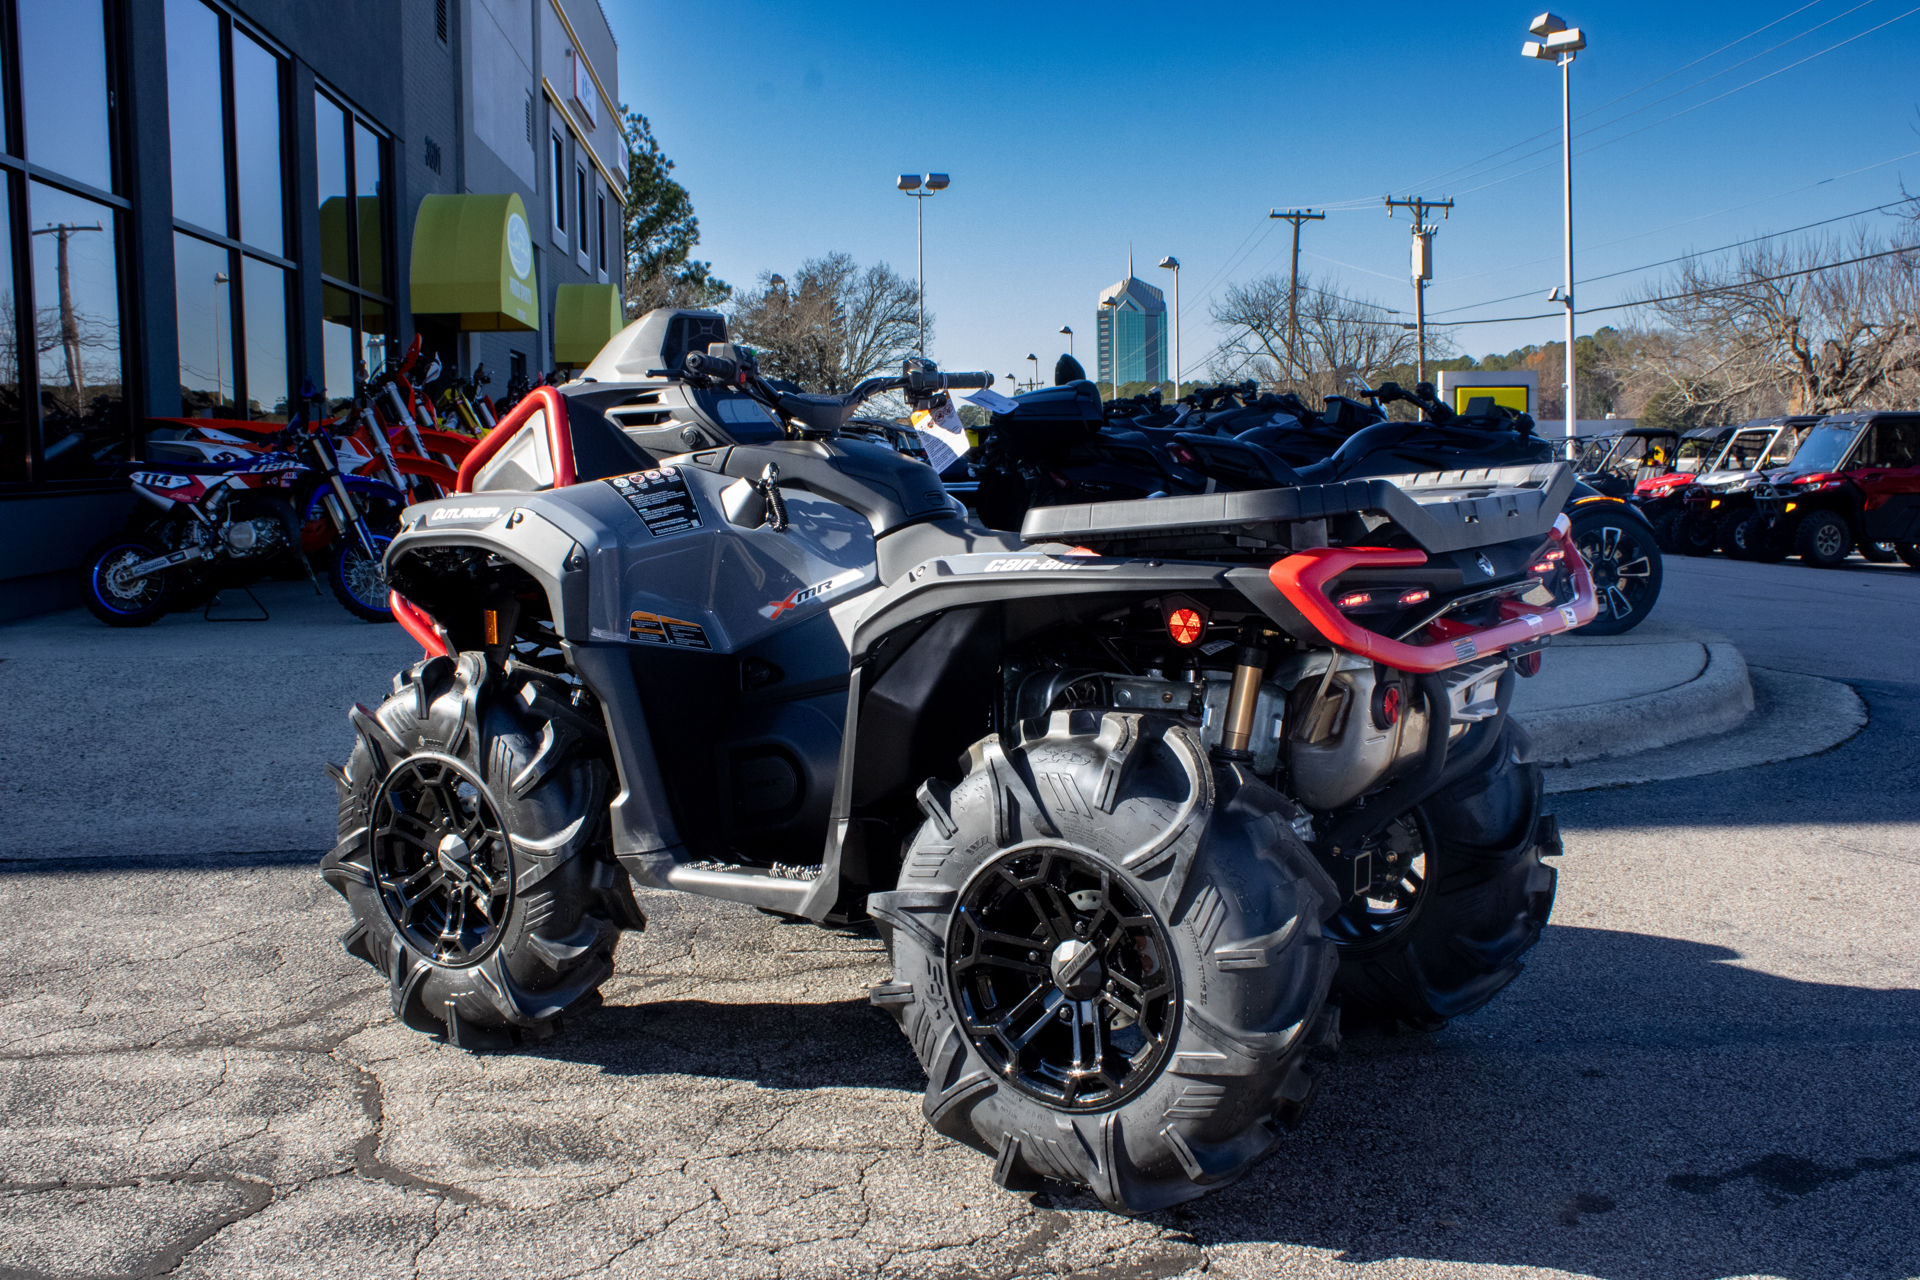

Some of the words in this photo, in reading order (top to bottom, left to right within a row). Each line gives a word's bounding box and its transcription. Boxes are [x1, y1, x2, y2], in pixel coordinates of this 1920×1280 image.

[248, 459, 297, 474] USA
[141, 473, 172, 486] 114
[431, 507, 501, 521] OUTLANDER
